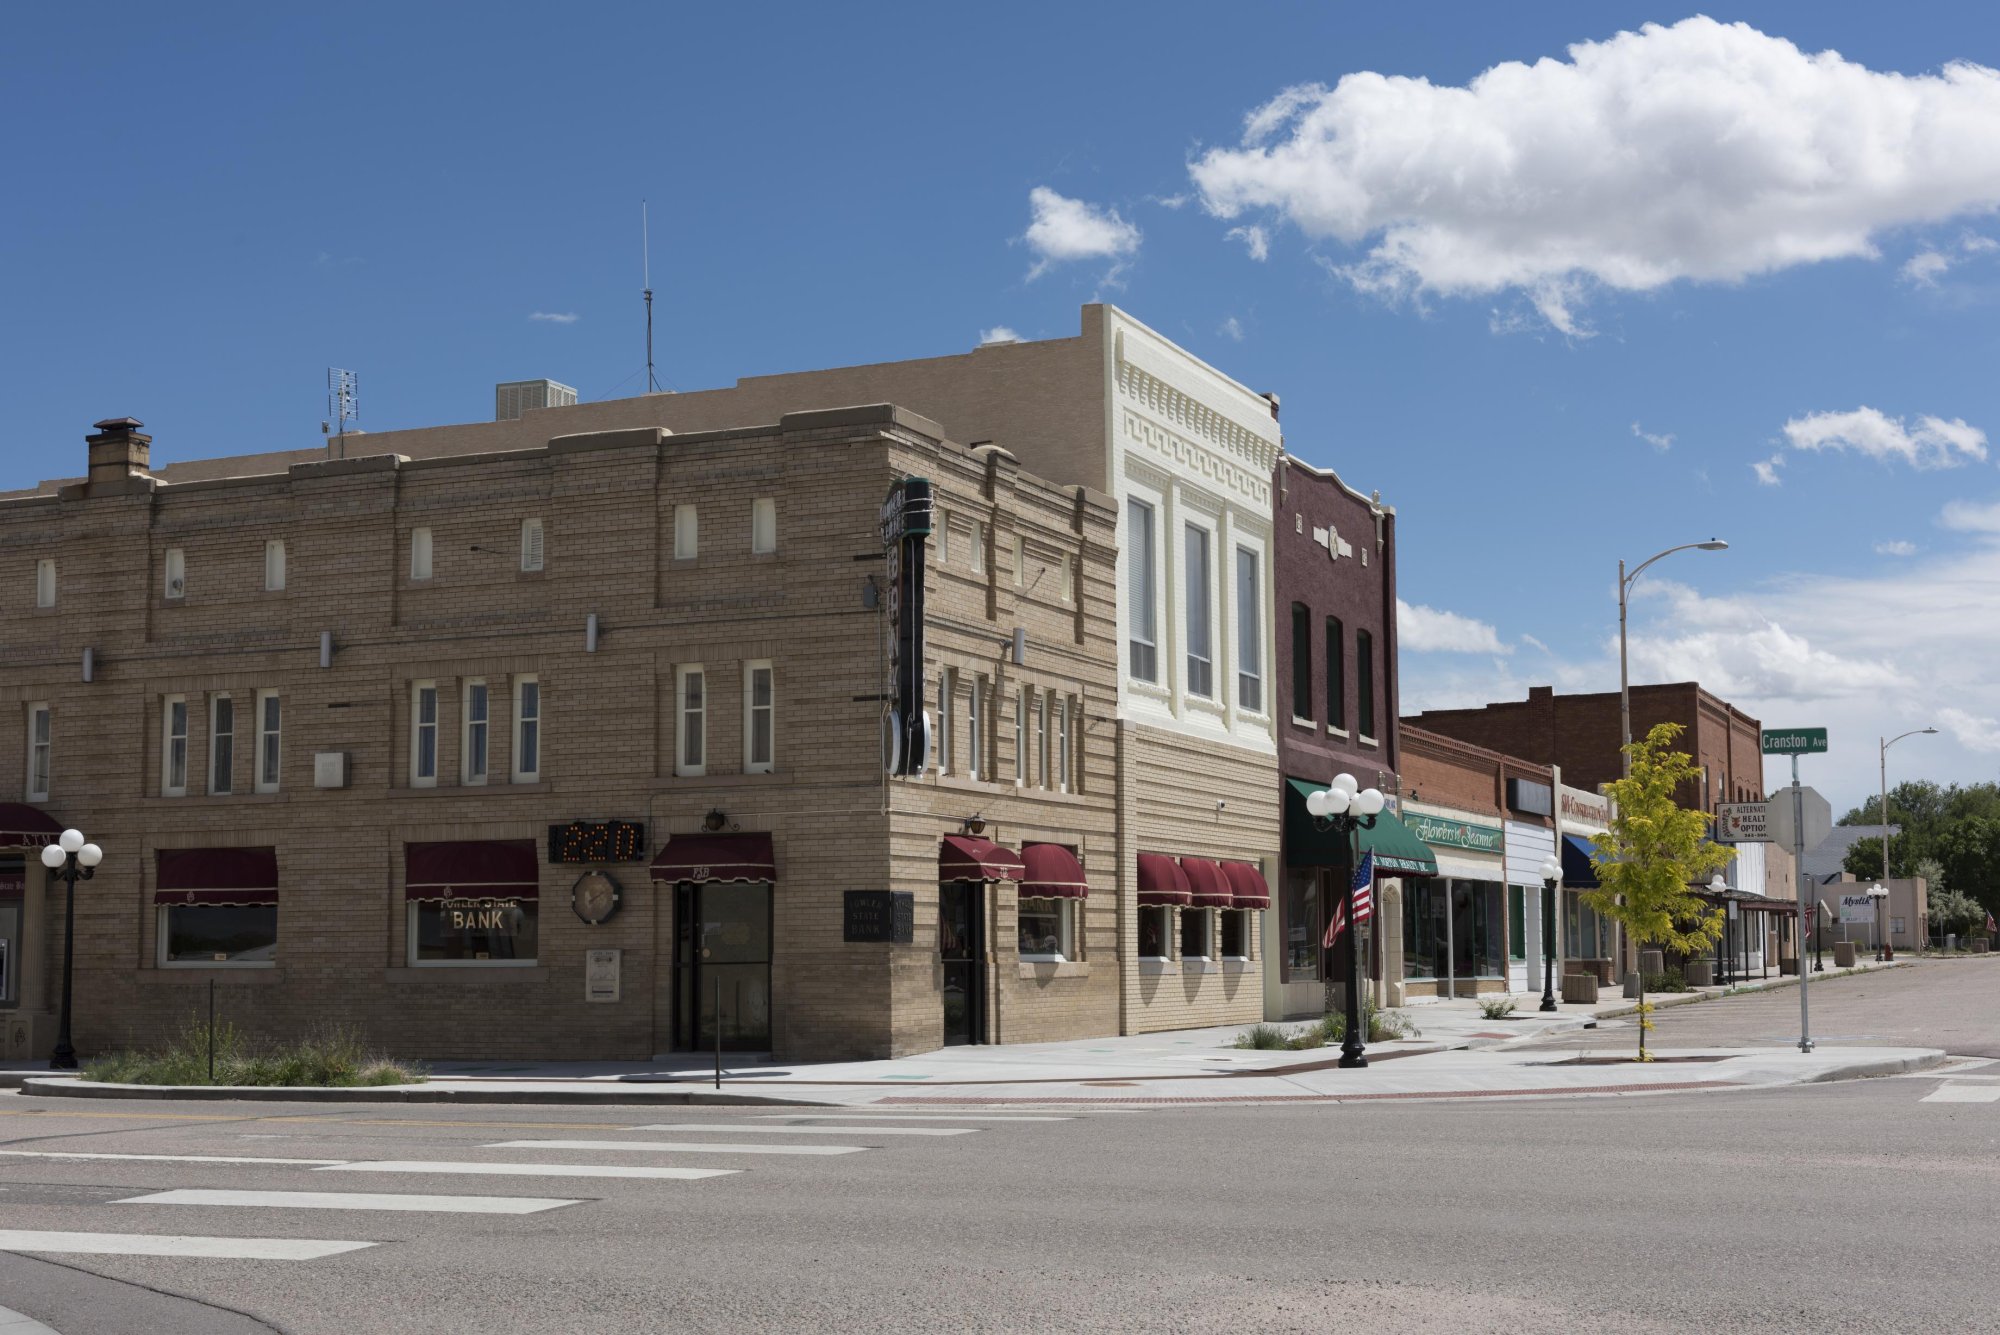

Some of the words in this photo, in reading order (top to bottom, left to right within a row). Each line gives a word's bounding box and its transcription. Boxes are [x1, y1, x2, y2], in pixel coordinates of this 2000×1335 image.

[1763, 733, 1808, 750] Cranston
[1813, 736, 1827, 748] Ave
[1736, 805, 1766, 814] ALTERNATI
[1742, 815, 1766, 823] HEALT
[1415, 817, 1454, 841] Flowers
[1461, 825, 1494, 848] Jeanne
[23, 834, 51, 846] ATM
[1842, 896, 1871, 907] Mystik
[453, 911, 503, 929] BANK
